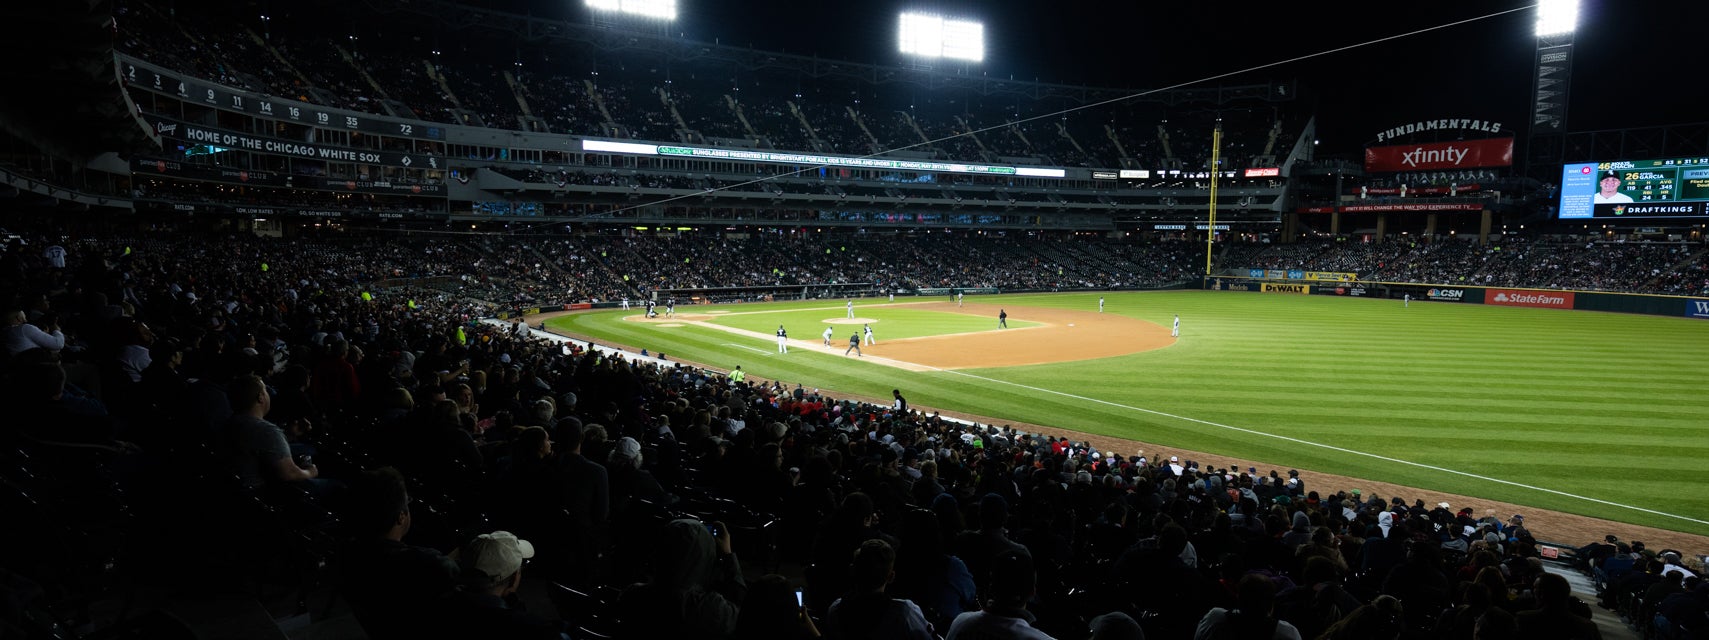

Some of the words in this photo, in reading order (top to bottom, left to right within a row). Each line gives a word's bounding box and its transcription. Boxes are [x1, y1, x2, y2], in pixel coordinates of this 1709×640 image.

[129, 65, 135, 78] 2
[154, 74, 161, 86] 3
[178, 82, 186, 93] 4
[207, 89, 215, 100] 9
[233, 96, 242, 106] 11
[260, 101, 272, 112] 14
[289, 106, 300, 117] 16
[317, 112, 328, 122] 19
[346, 116, 358, 126] 35
[157, 122, 177, 136] Chicago
[400, 124, 412, 134] 72
[1377, 119, 1502, 142] FUNDAMENTALS
[187, 128, 220, 143] HOME
[223, 134, 238, 145] OF
[240, 137, 262, 149] THE
[266, 141, 315, 156] CHICAGO
[318, 148, 356, 161] WHITE
[359, 152, 380, 163] SOX
[1402, 146, 1469, 167] xfinity
[1441, 289, 1463, 297] CSN
